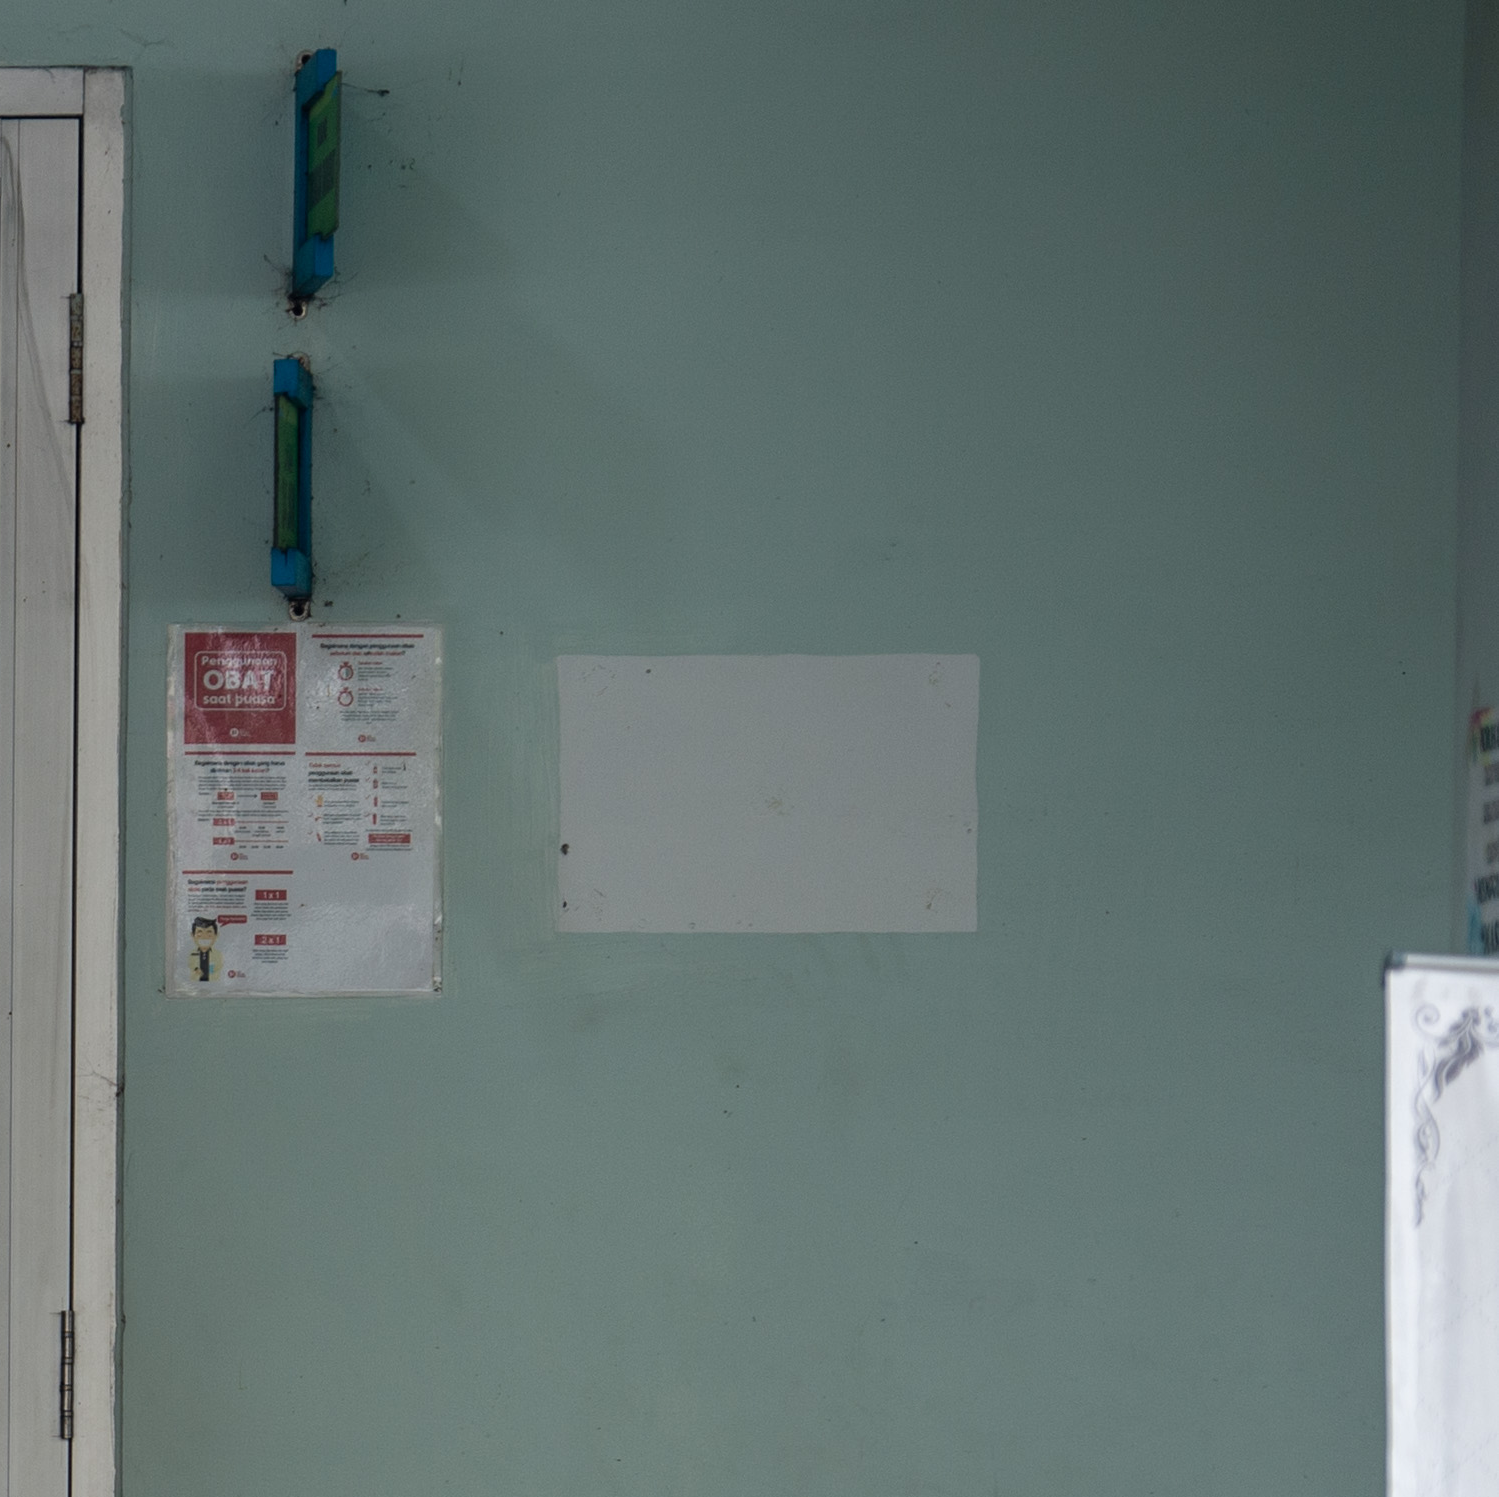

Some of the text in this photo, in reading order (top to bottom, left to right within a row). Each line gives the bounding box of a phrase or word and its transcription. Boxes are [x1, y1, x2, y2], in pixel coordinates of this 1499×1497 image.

[201, 656, 277, 668] Penggunaan
[203, 669, 274, 691] OBAT
[203, 694, 275, 707] saat puasa
